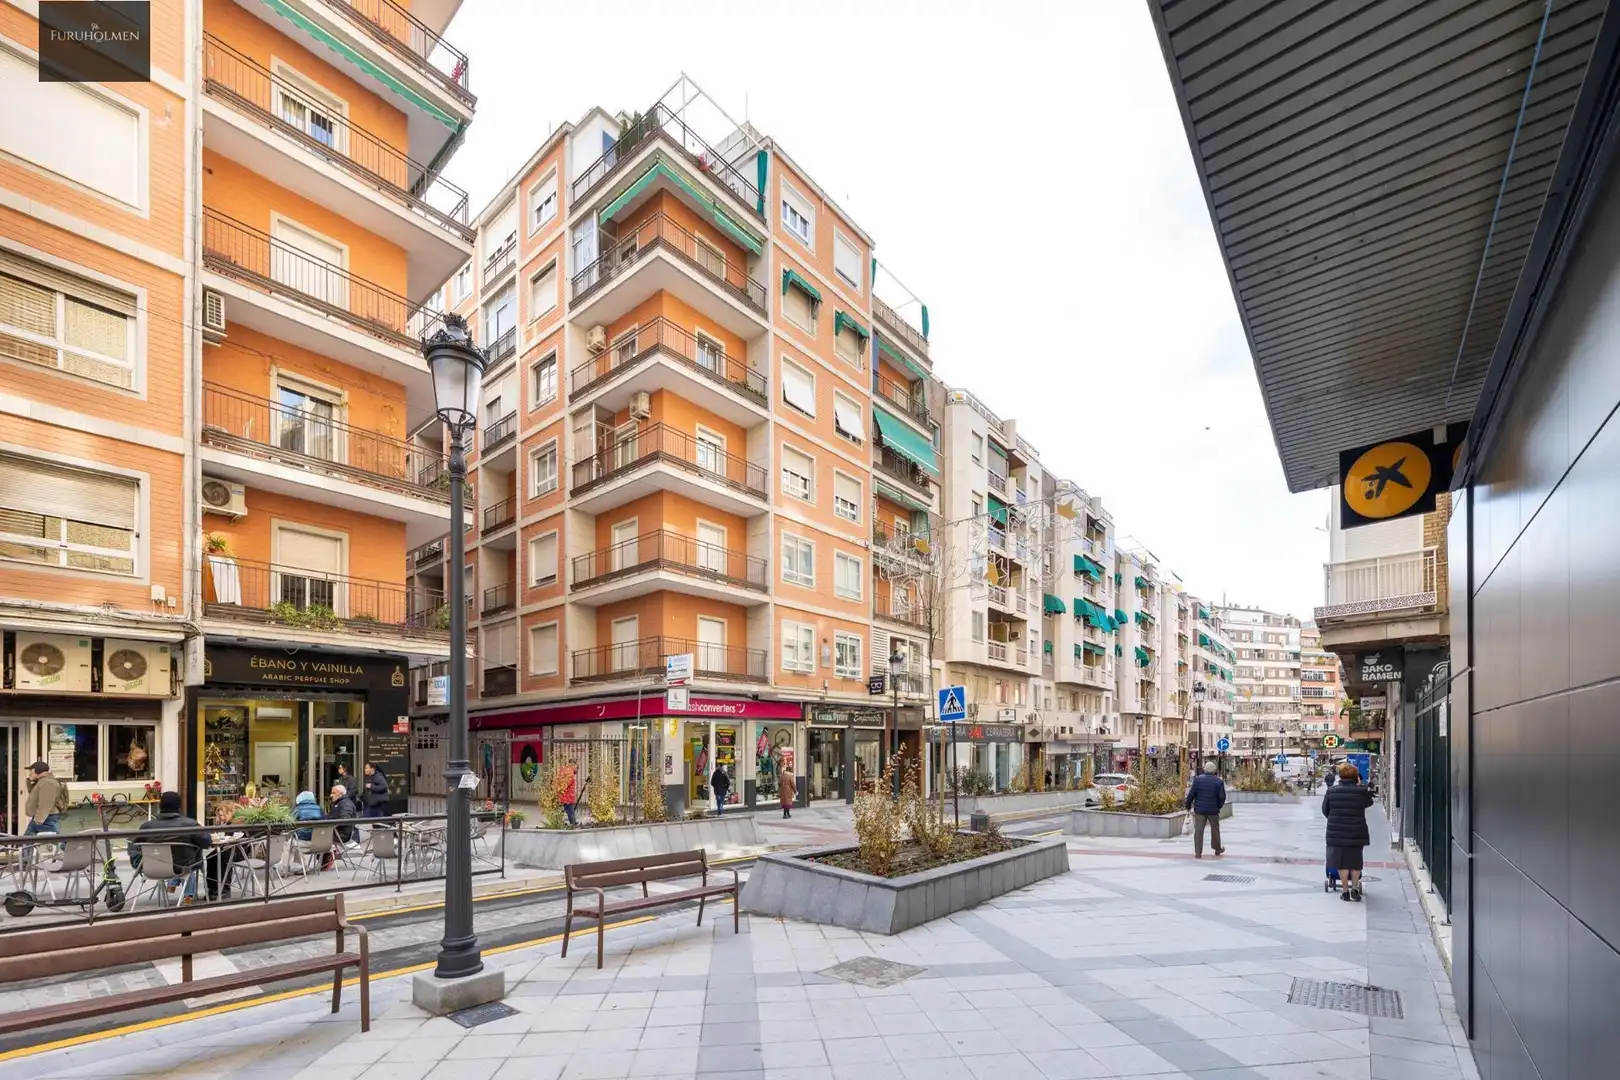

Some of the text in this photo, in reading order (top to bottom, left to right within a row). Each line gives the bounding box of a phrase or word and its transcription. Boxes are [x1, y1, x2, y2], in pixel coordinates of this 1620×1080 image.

[250, 655, 364, 675] ÉBANO Y VAINILLA
[1362, 664, 1393, 673] JAKO
[262, 673, 293, 681] ARABIC
[1362, 671, 1402, 681] RAMEN
[688, 701, 736, 713] ashconverters
